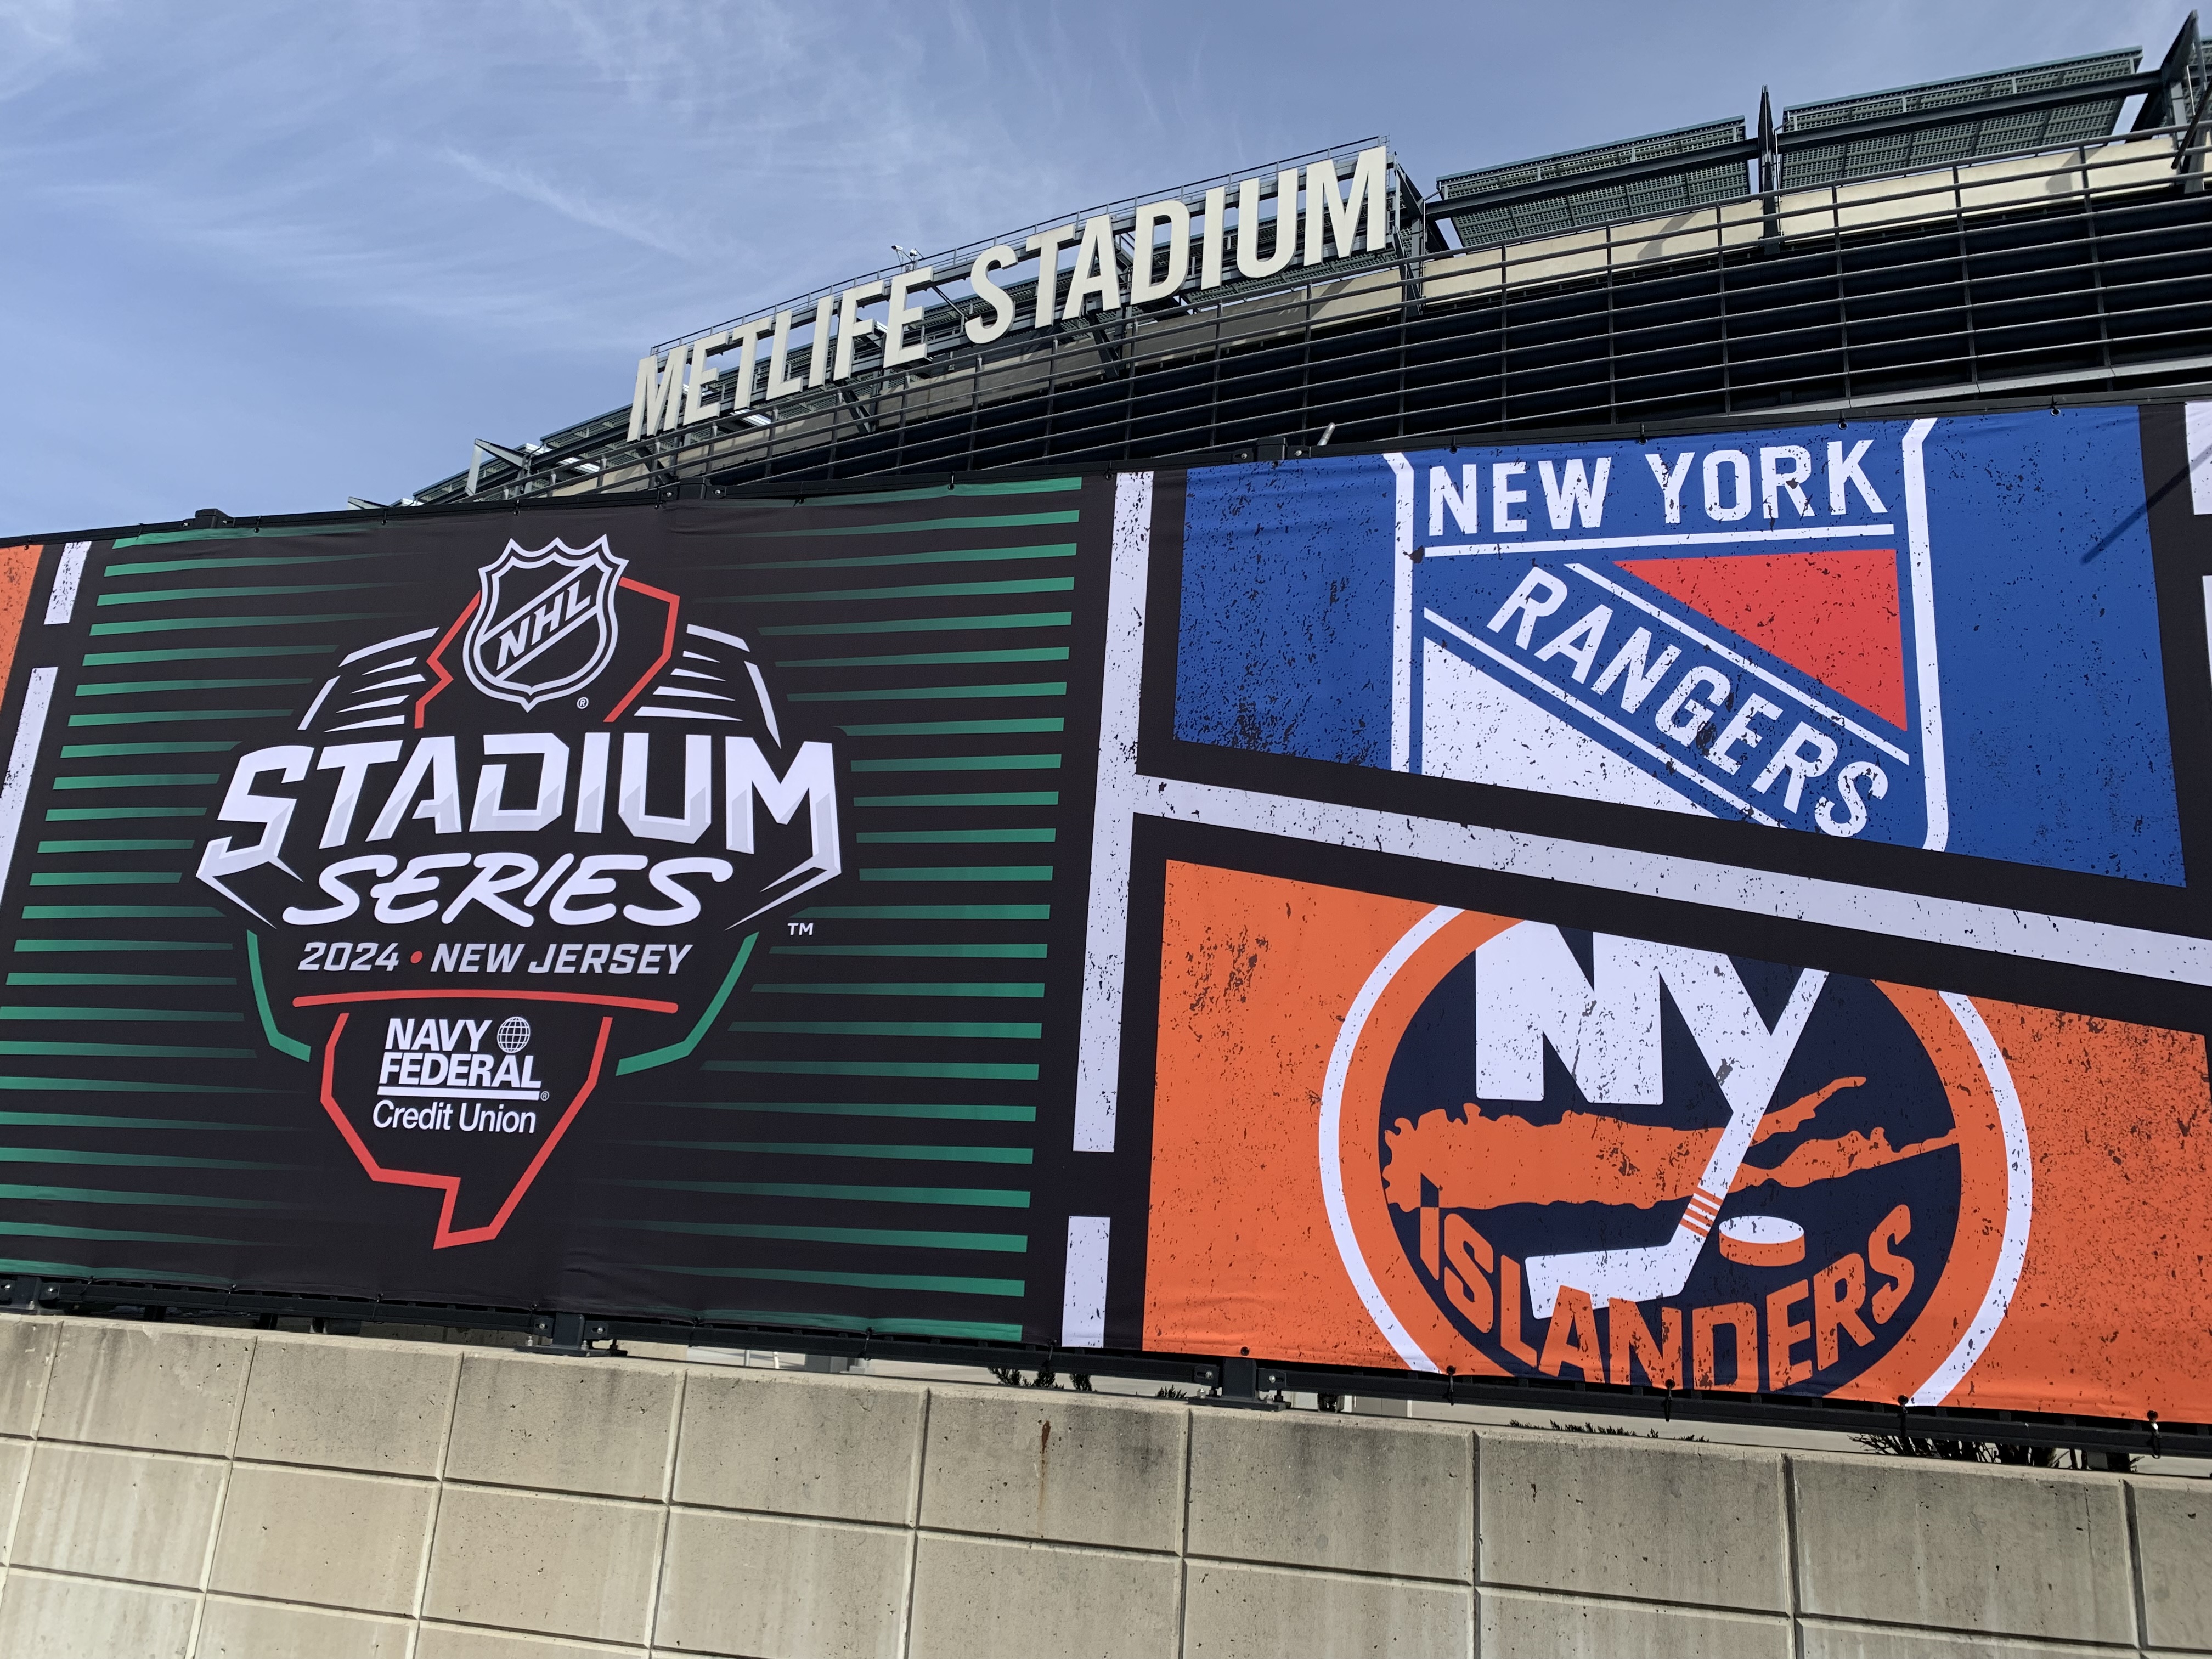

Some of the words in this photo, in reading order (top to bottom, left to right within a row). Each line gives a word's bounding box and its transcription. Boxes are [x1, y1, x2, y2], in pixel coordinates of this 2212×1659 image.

[627, 266, 934, 441] METLIFE
[965, 145, 1390, 345] STADIUM
[1429, 457, 1611, 536] NEW
[1645, 440, 1888, 523] YORK
[497, 580, 591, 670] NHL
[1487, 566, 1889, 838] RANGERS
[196, 732, 841, 884] STADIUM
[283, 853, 733, 927] SERIES
[298, 942, 399, 971] 2024
[431, 944, 525, 972] NEW
[528, 944, 693, 974] JERSEY
[379, 1052, 541, 1088] FEDERAL
[385, 1018, 492, 1051] NAVY
[373, 1100, 453, 1130] Credit
[459, 1103, 535, 1133] Union
[1420, 1174, 1915, 1392] ISLANDERS
